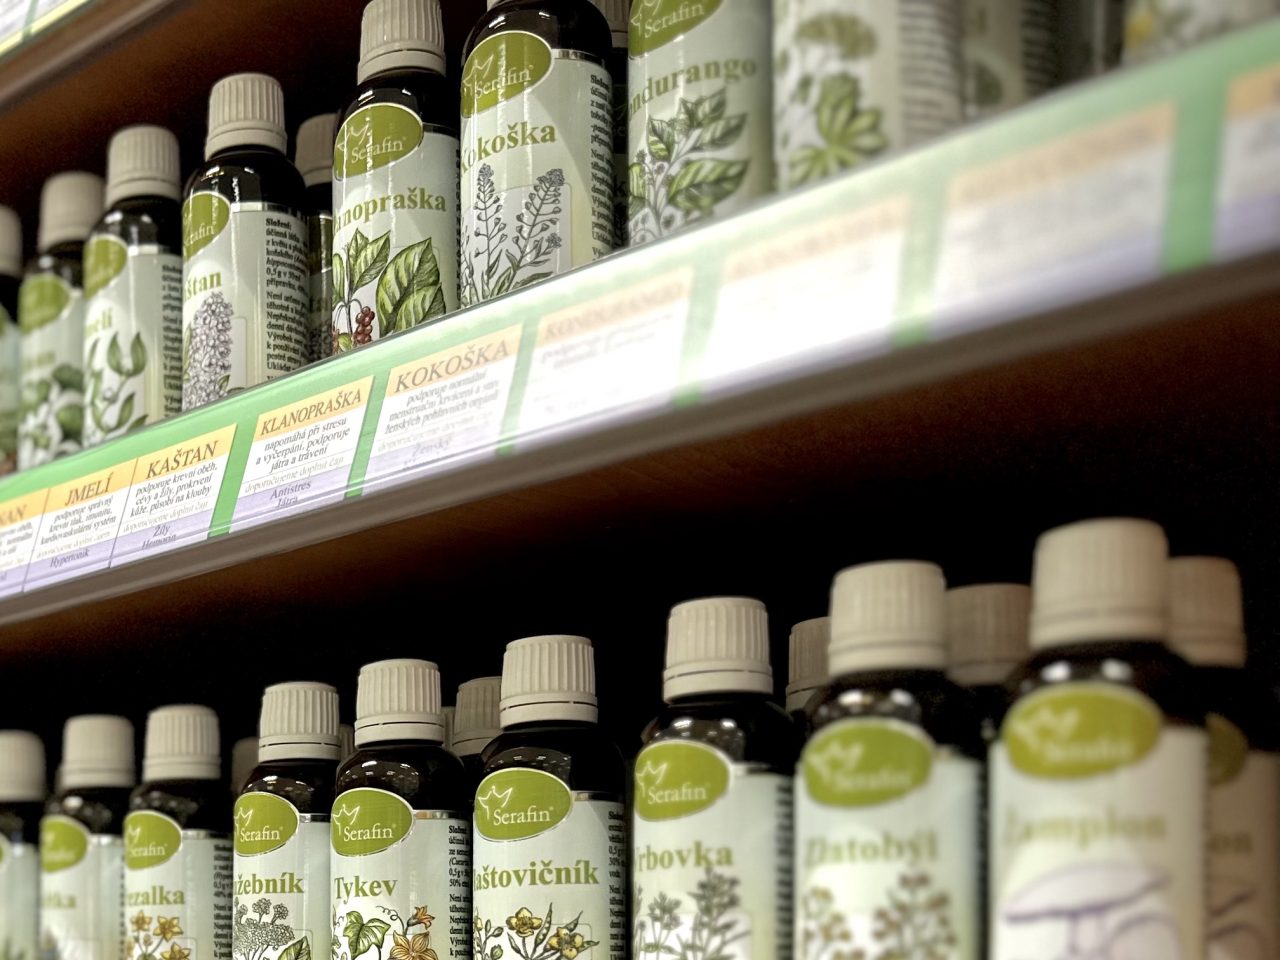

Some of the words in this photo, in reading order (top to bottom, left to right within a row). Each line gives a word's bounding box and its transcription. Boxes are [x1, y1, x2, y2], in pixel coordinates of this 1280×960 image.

[645, 3, 704, 38] Serafin
[630, 58, 757, 116] ndurango
[183, 270, 222, 301] štan
[395, 339, 509, 393] KOKOŠKA
[260, 388, 362, 436] KLANOPRAŠKA
[264, 429, 307, 453] napomáhá
[308, 426, 321, 440] při
[322, 417, 347, 433] stresu
[306, 428, 350, 452] podporuje
[145, 440, 219, 479] KAŠTAN
[270, 457, 289, 474] játra
[298, 444, 327, 462] trávení
[64, 472, 114, 506] JMELÍ
[136, 476, 172, 497] podporuje
[173, 468, 195, 483] krevní
[270, 480, 311, 500] Antistres
[647, 782, 707, 804] Serafin
[493, 805, 551, 826] Serafin
[239, 826, 281, 842] Serafin
[343, 823, 393, 842] Serafin
[636, 840, 734, 872] rbovka
[233, 872, 305, 896] žebník
[334, 875, 398, 905] Tykev
